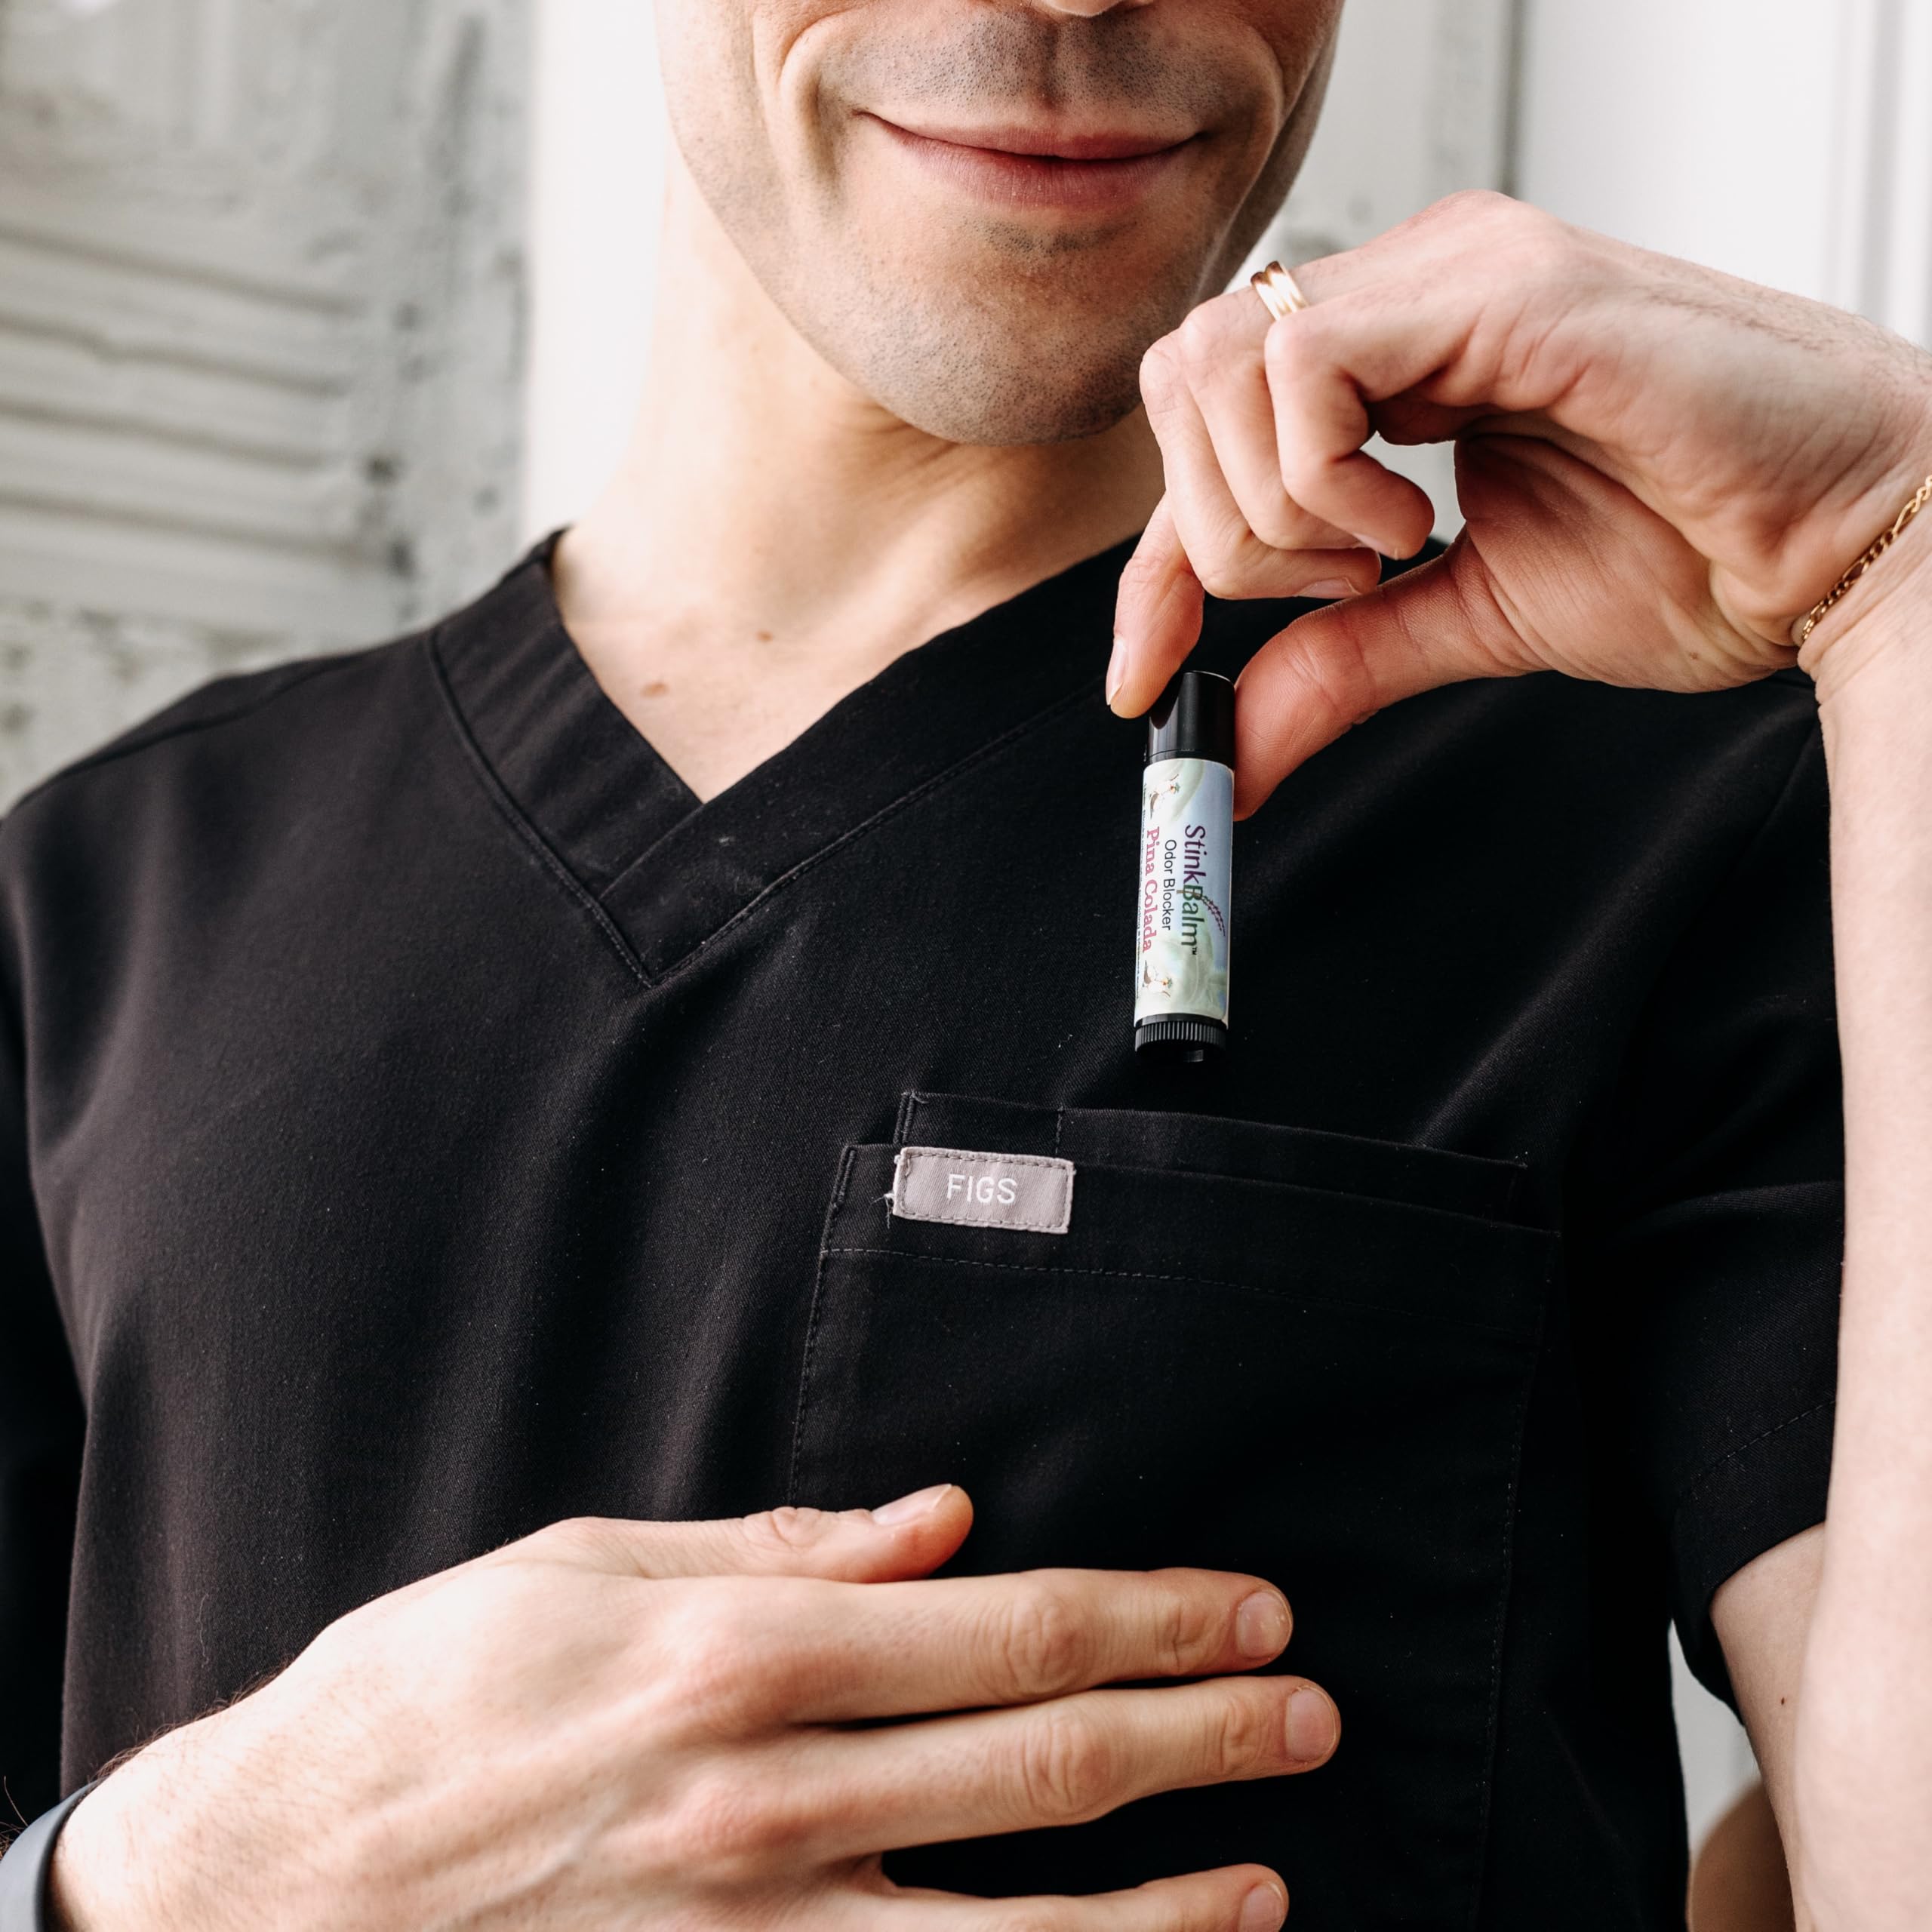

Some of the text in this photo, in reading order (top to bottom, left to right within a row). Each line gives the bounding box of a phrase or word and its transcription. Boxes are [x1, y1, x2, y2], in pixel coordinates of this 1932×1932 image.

[1143, 826, 1160, 953] Pina Colada
[1162, 839, 1177, 931] Odor Blocker
[946, 1174, 1018, 1204] FIGS
